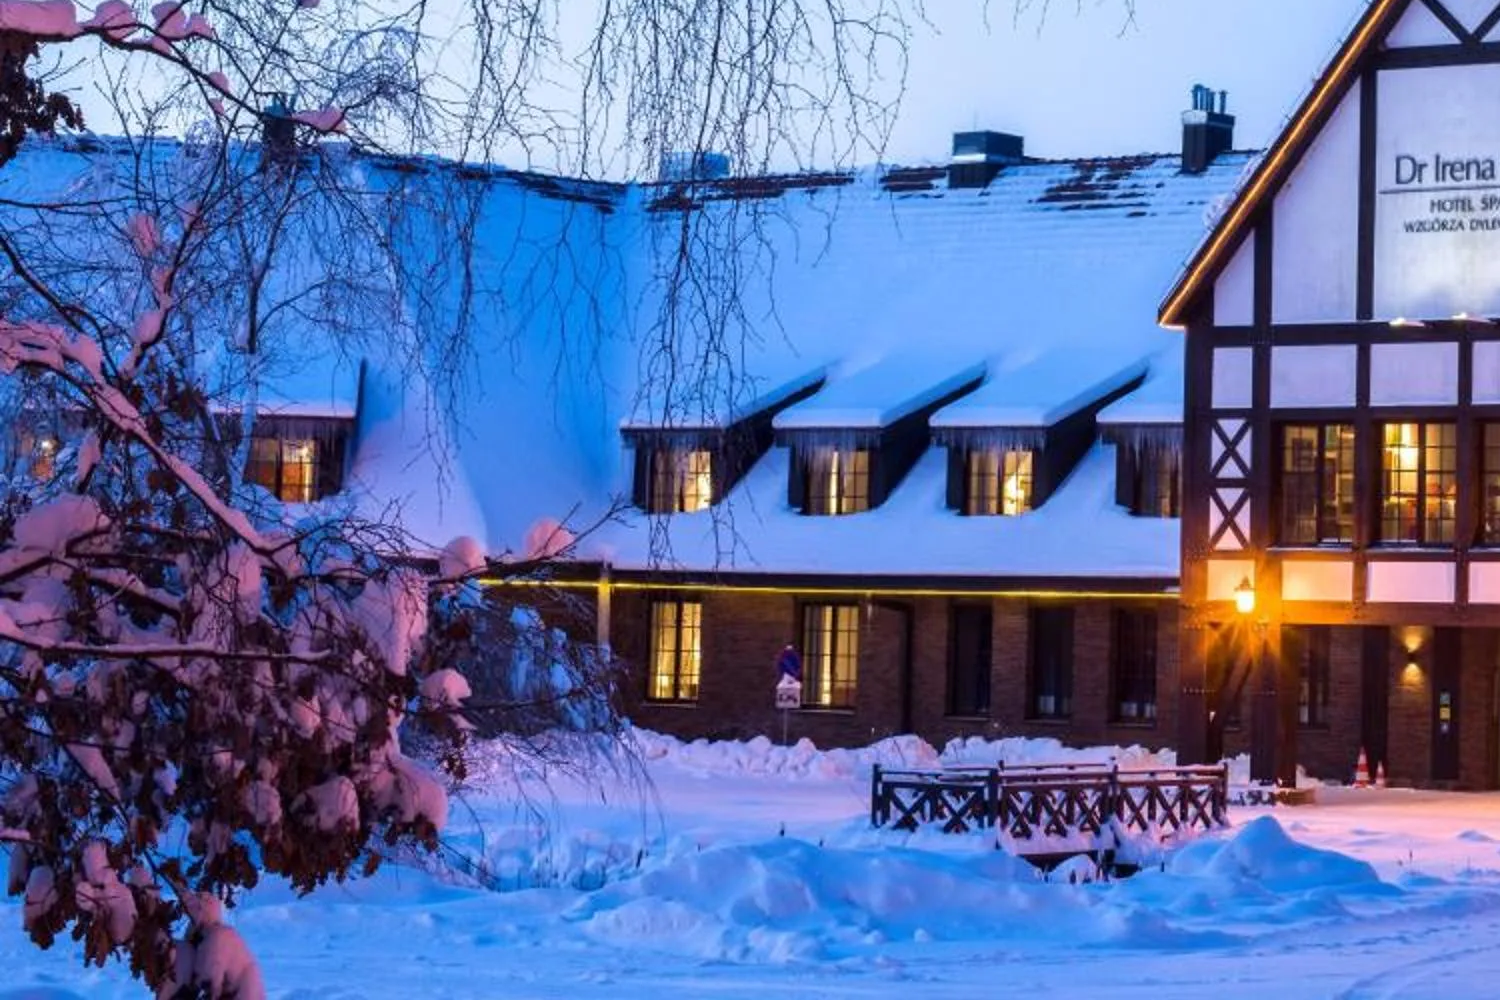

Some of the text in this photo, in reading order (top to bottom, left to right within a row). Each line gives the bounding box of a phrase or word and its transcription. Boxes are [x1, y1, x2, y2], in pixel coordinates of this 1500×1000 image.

[1395, 155, 1428, 185] Dr
[1435, 153, 1495, 183] Irena
[1430, 196, 1474, 213] HOTEL
